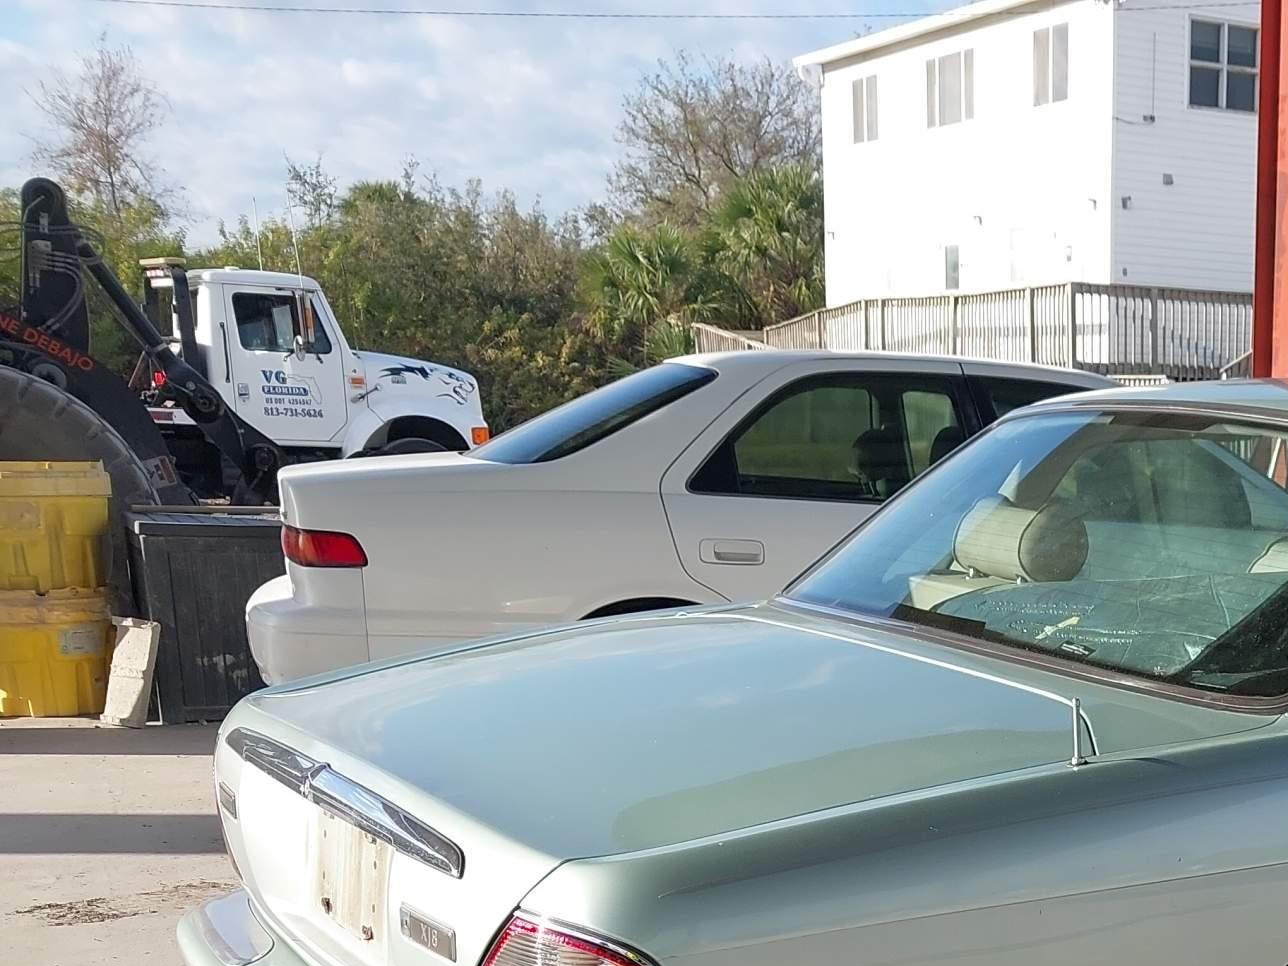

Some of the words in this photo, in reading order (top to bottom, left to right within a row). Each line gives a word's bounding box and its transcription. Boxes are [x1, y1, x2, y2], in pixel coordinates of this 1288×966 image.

[23, 327, 94, 370] DEBAJO
[260, 369, 287, 384] VG
[264, 385, 306, 395] FLORIDA
[420, 922, 438, 948] XJ8
